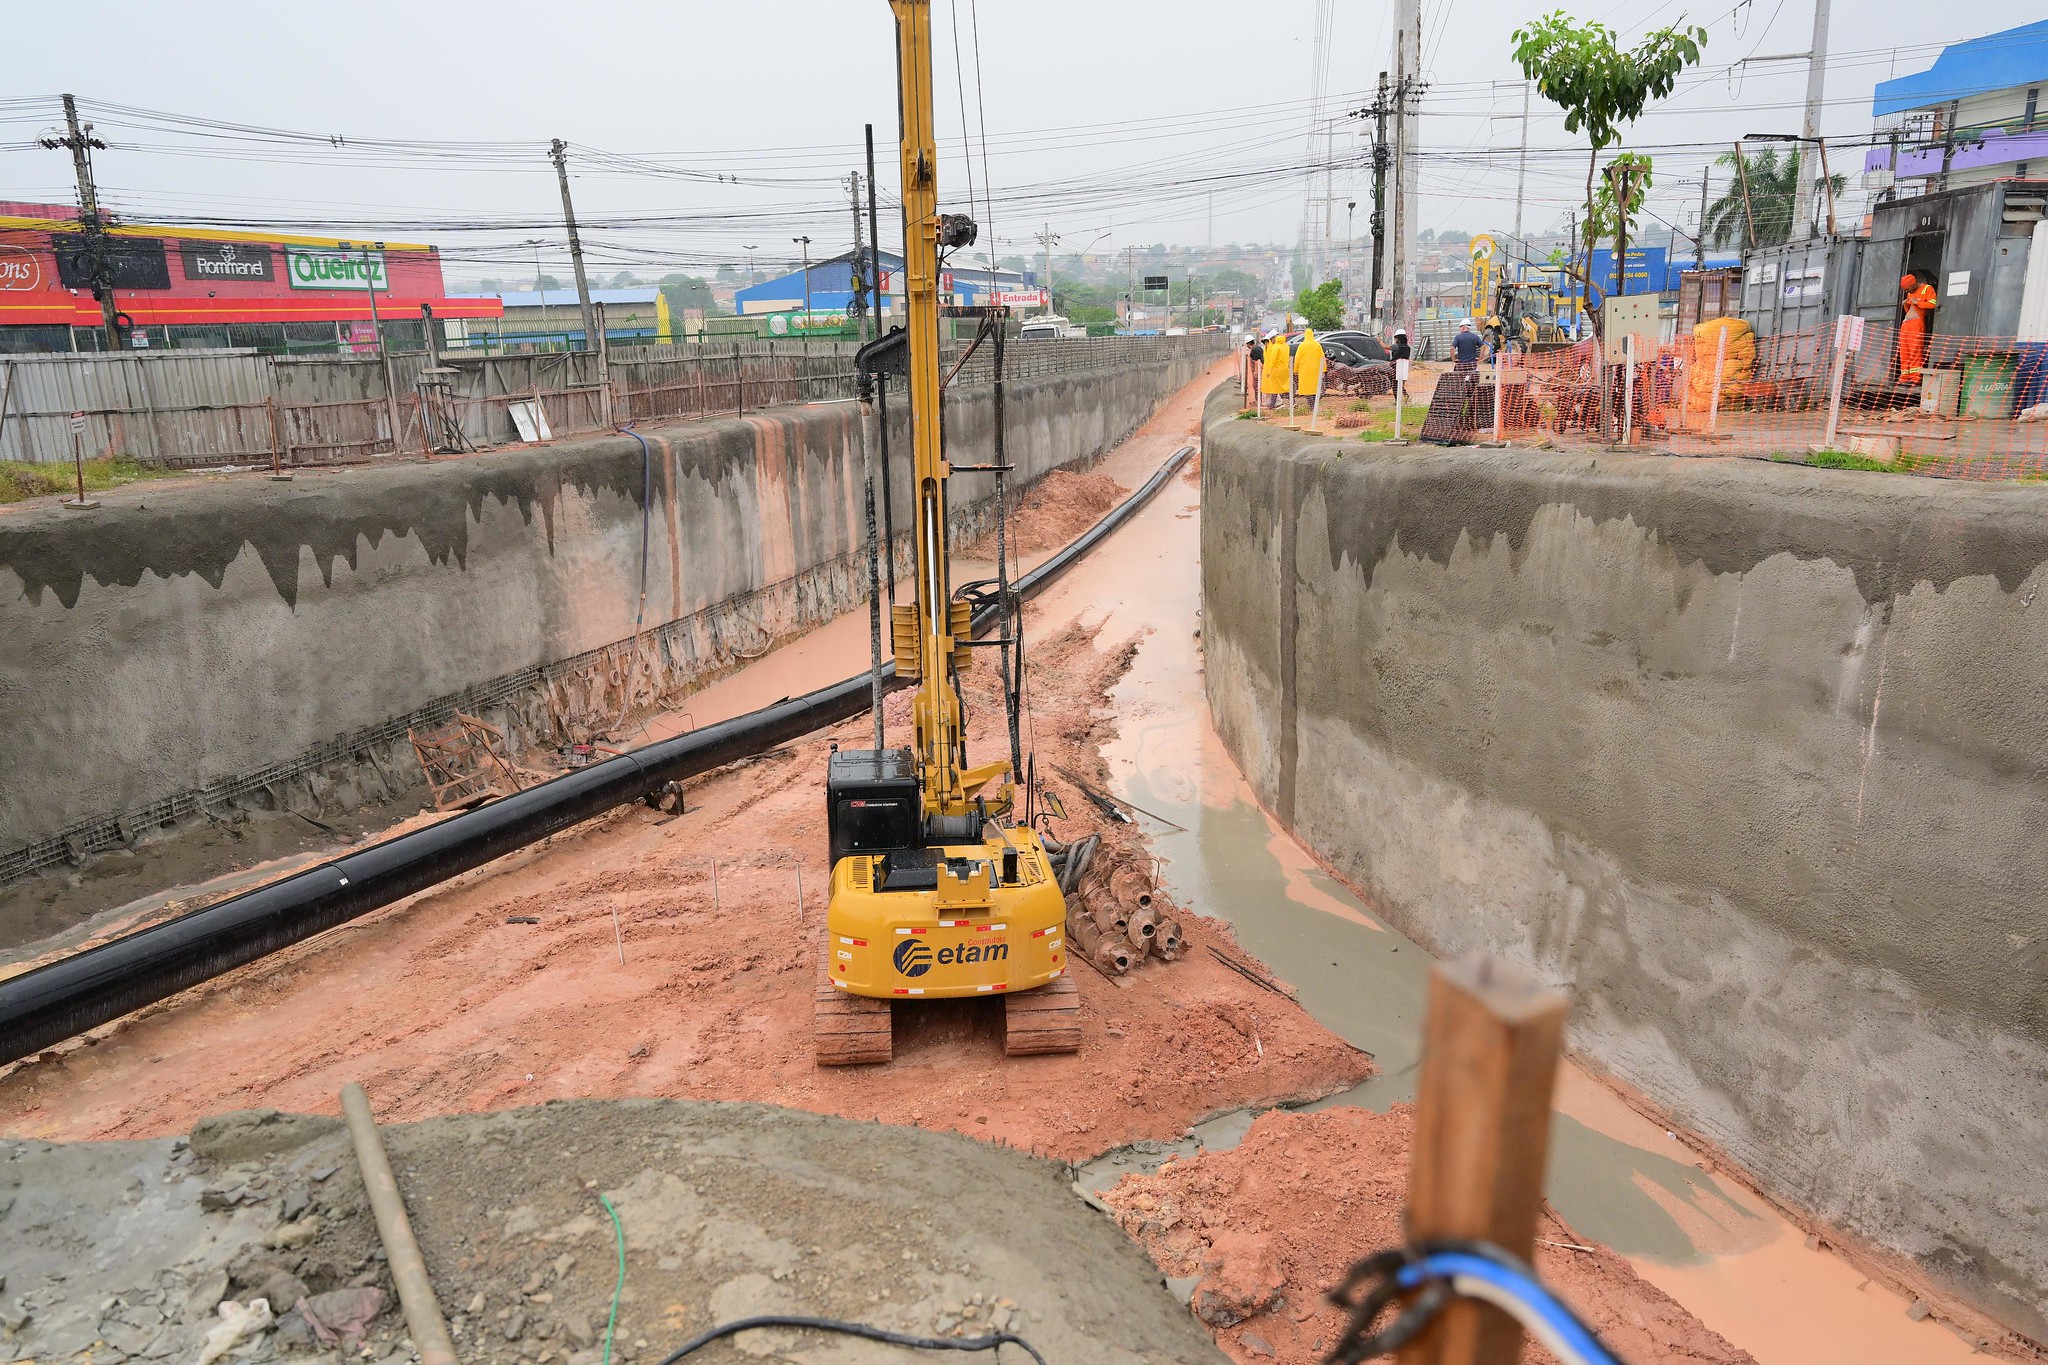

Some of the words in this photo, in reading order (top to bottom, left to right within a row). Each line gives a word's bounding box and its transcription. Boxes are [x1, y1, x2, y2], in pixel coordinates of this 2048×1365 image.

[1922, 216, 1931, 226] 01
[294, 252, 383, 282] Queiroz
[1475, 266, 1483, 291] Pedro
[1002, 293, 1038, 303] Entrada
[967, 936, 1007, 946] Construtora
[937, 942, 1009, 965] etam
